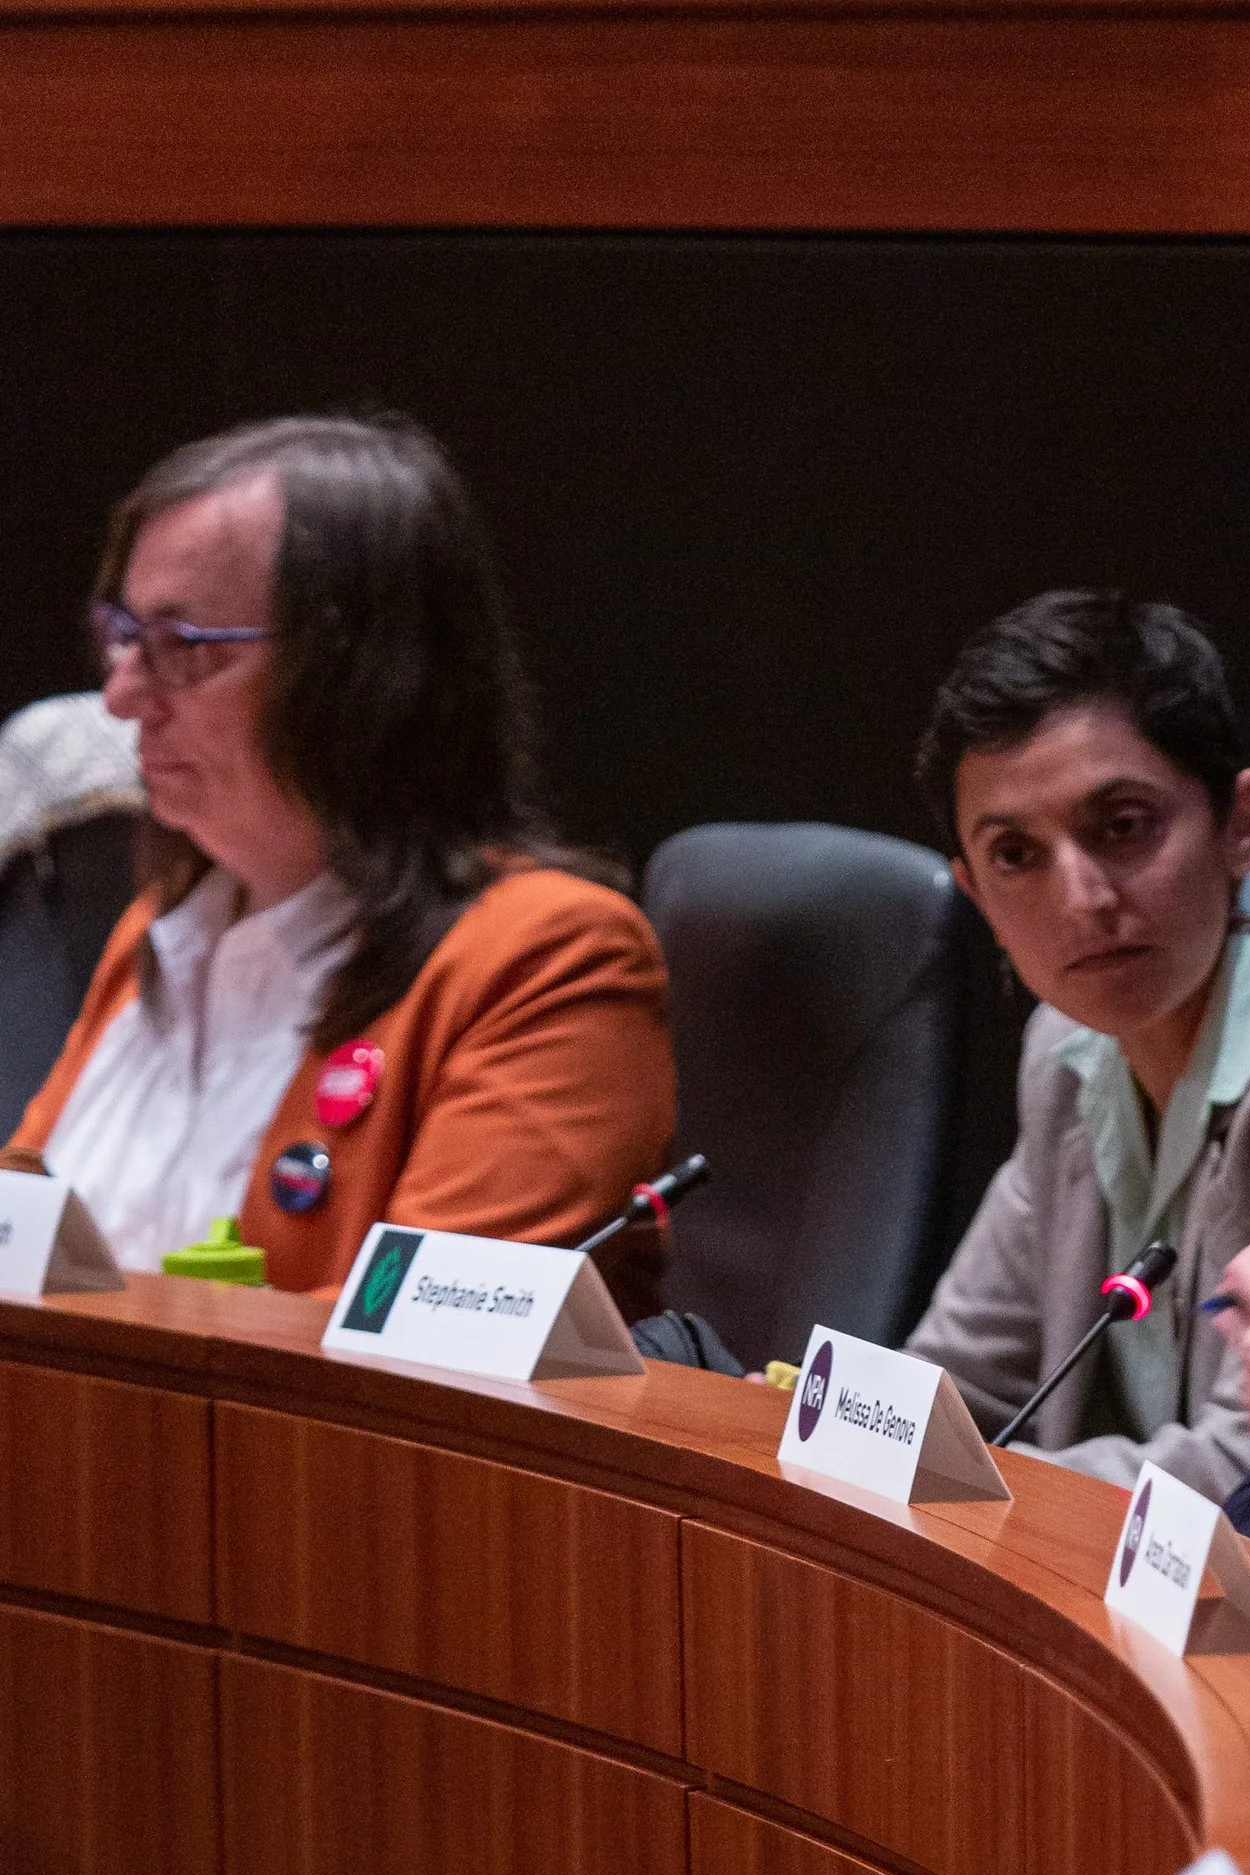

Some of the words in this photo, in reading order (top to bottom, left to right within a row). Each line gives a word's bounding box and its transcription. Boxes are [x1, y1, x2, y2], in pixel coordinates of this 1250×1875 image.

[412, 1275, 489, 1313] Stephanie
[488, 1286, 535, 1318] Smith
[801, 1372, 826, 1411] NPA
[835, 1386, 871, 1429] Melissa
[869, 1399, 884, 1433] De
[882, 1404, 916, 1446] Genova
